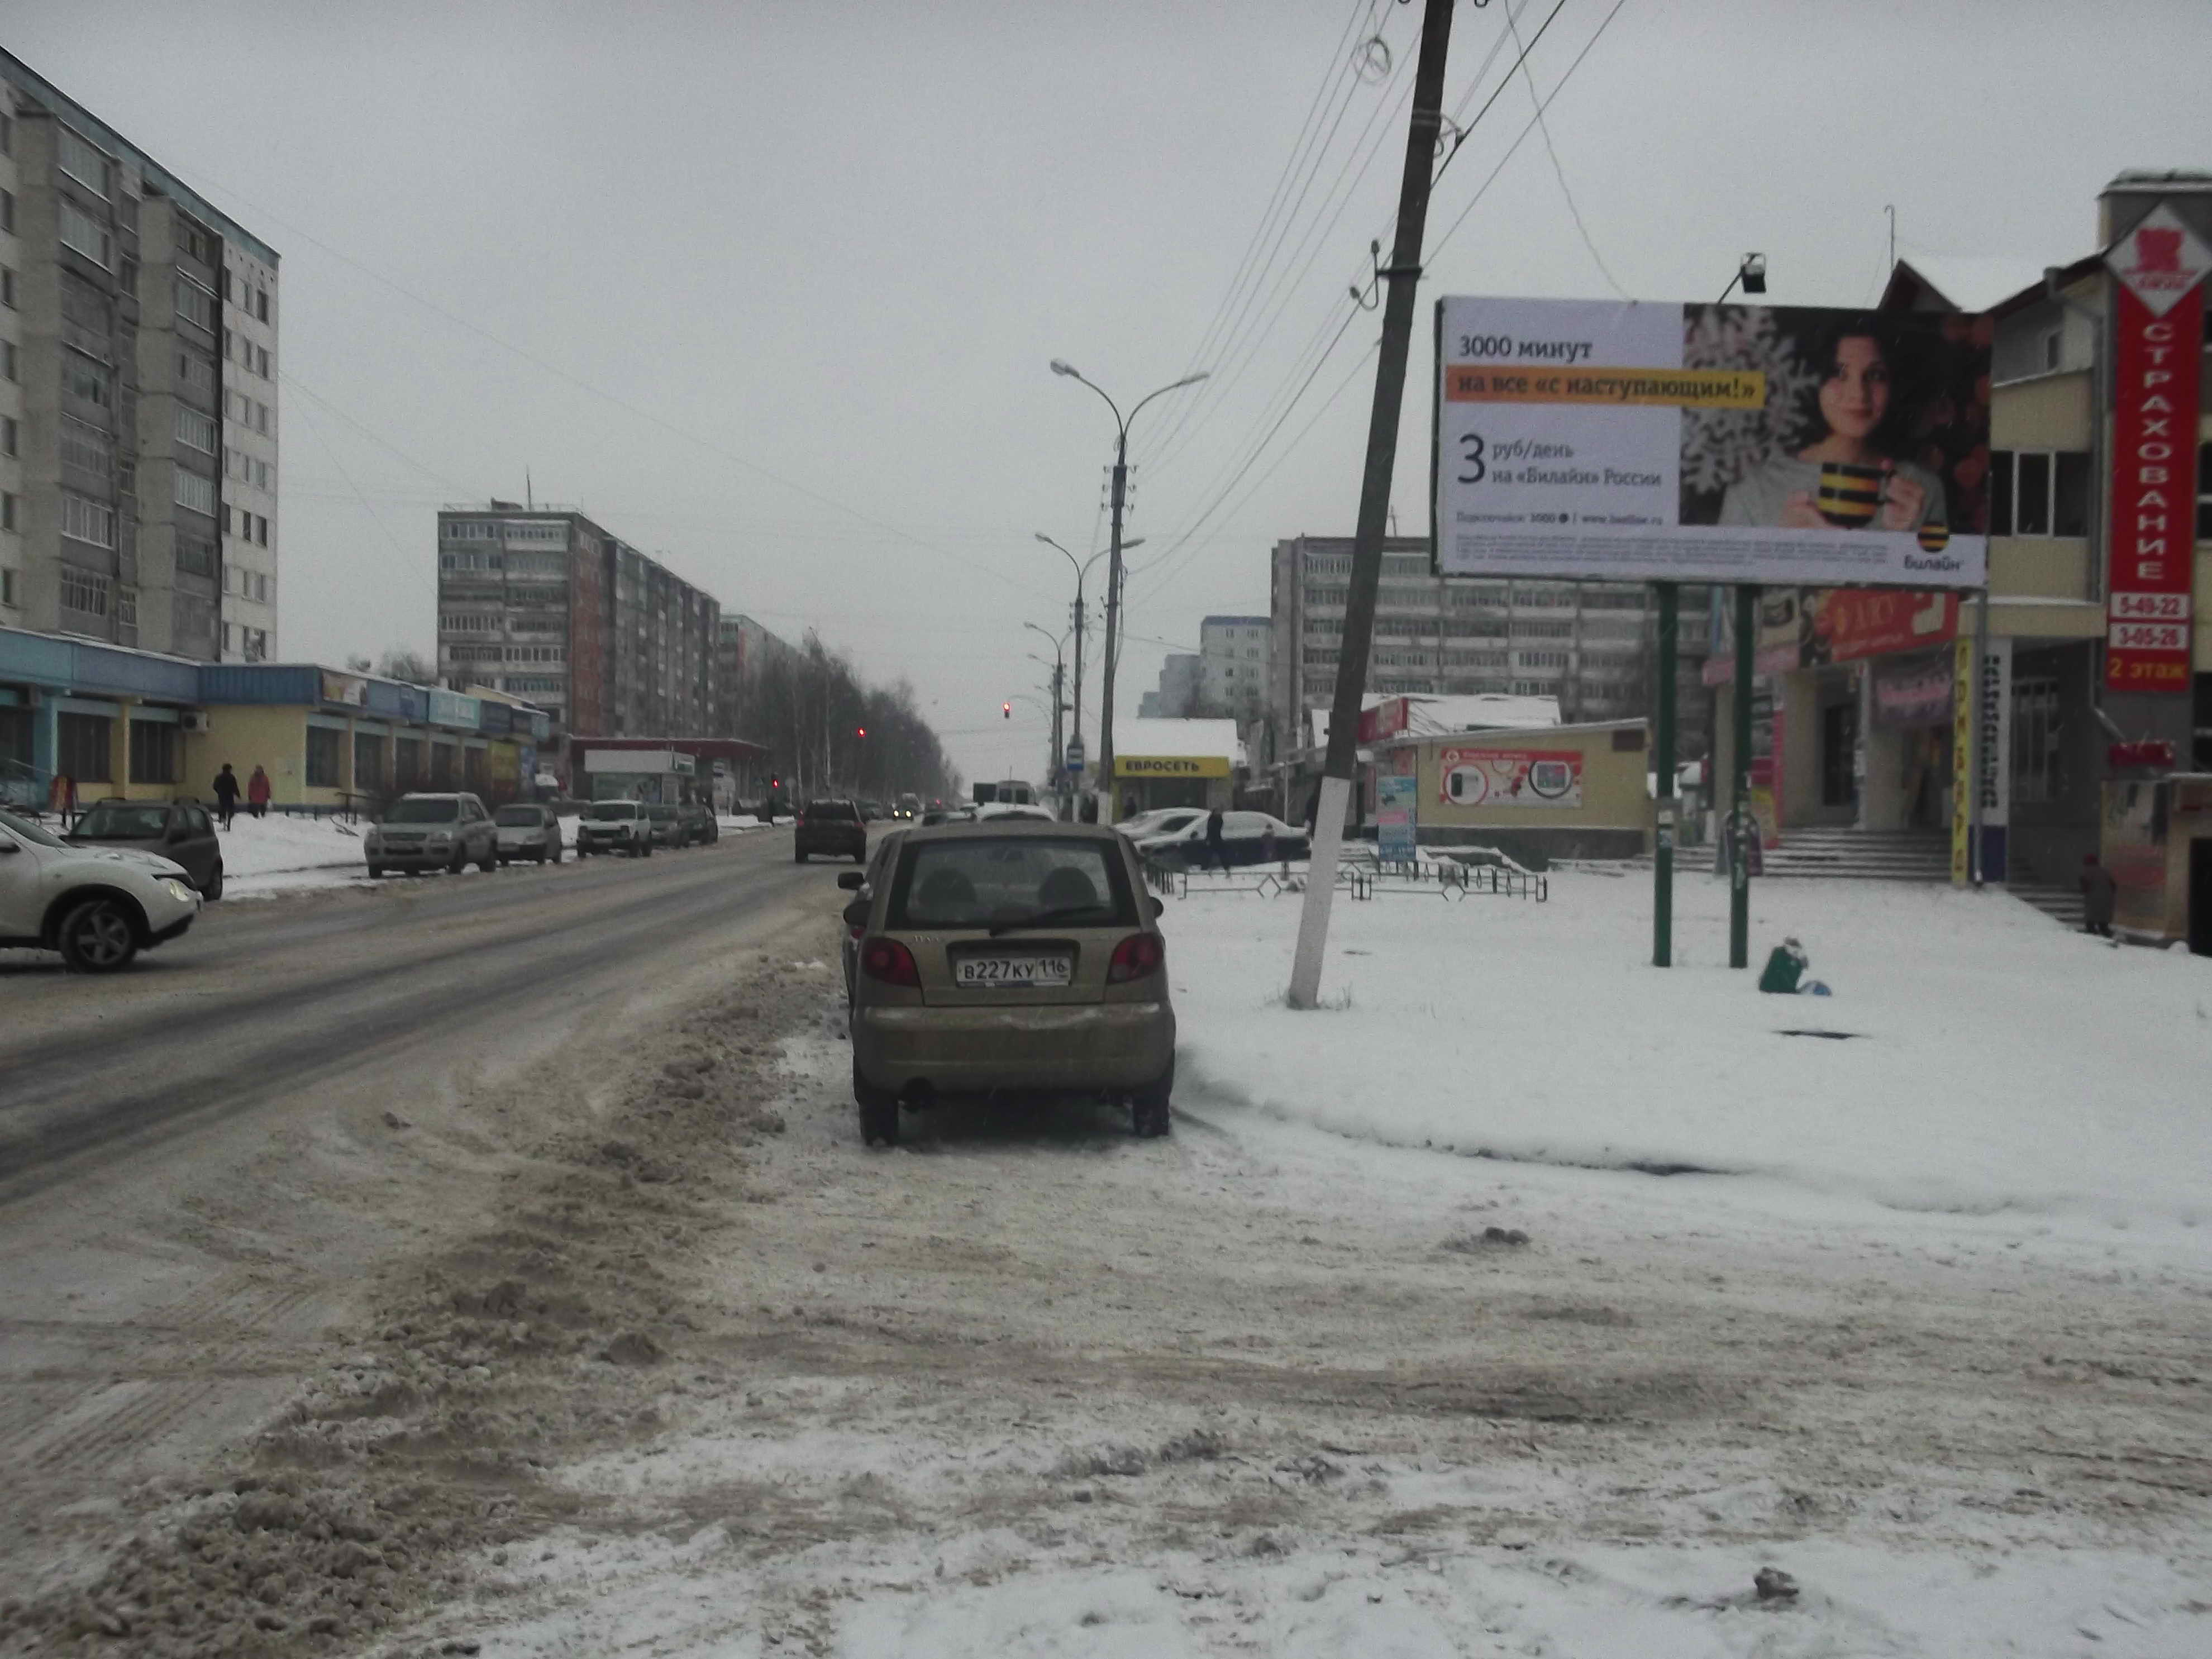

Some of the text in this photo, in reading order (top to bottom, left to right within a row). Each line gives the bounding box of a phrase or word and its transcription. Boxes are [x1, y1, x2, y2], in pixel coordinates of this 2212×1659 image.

[1458, 335, 1593, 364] 3000 минут
[1458, 375, 1486, 393] на
[1491, 376, 1528, 393] все
[1567, 378, 1755, 401] наступающим!»
[1457, 433, 1485, 484] 3
[1492, 438, 1574, 461] руб/день
[2136, 322, 2176, 580] СТРАХОВАНИЕ
[1492, 466, 1662, 487] на «Билайн» России
[2109, 656, 2186, 679] 2 этаж
[1126, 760, 1199, 771] ЕВРОСЕТЬ
